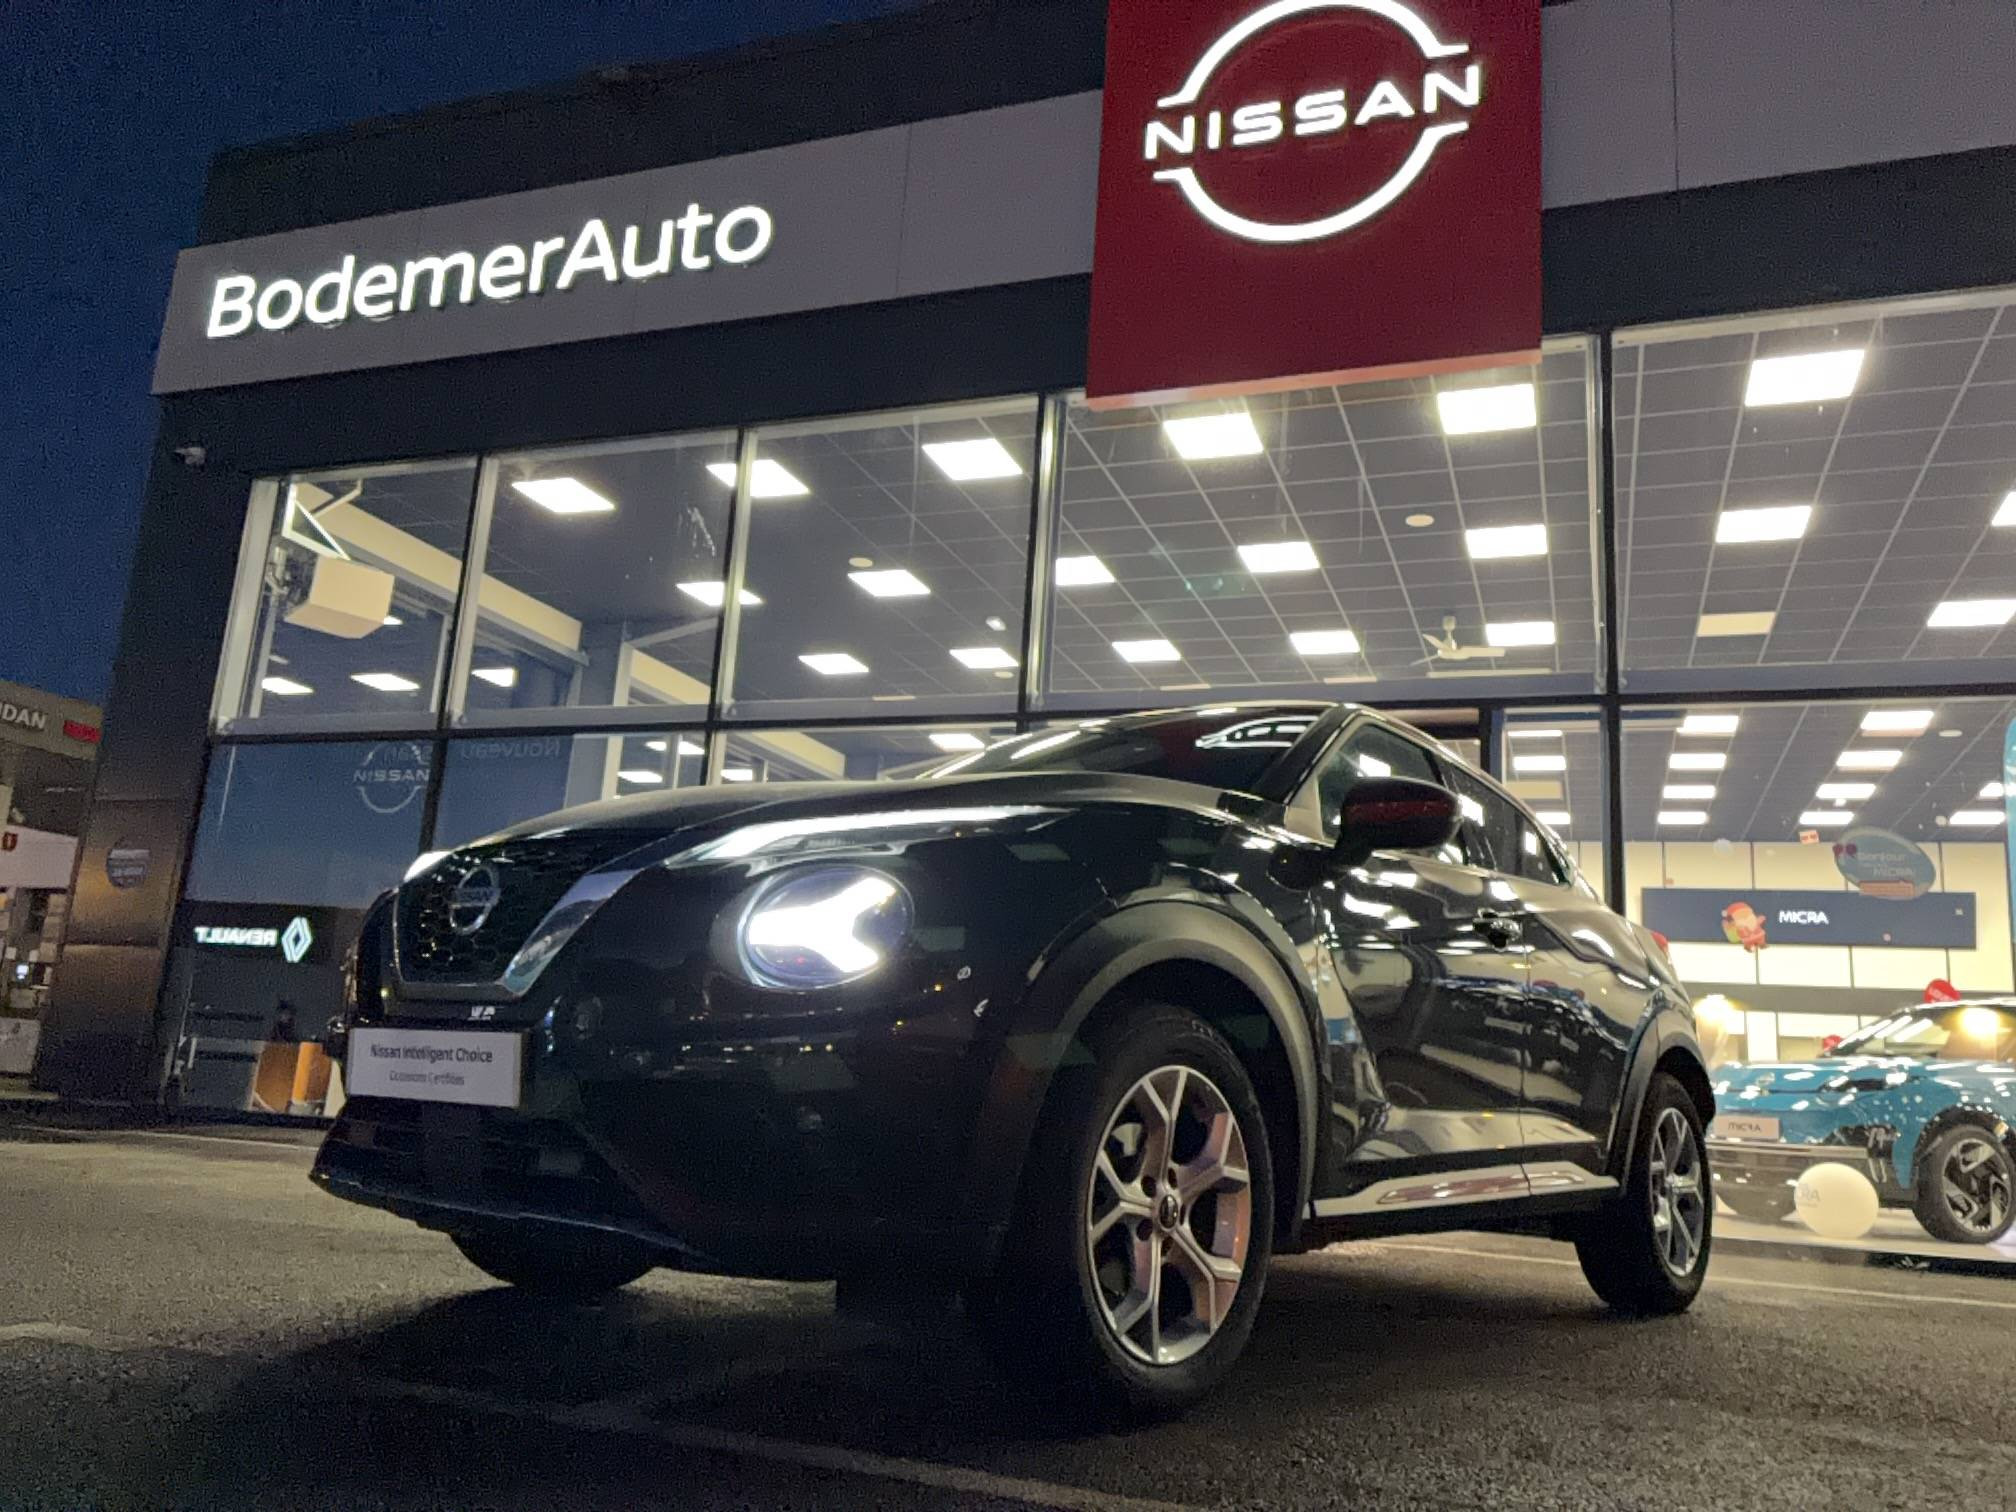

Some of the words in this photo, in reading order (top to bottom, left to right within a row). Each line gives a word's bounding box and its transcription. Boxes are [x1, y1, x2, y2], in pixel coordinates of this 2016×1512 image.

[1144, 63, 1482, 161] NISSAN
[206, 202, 773, 339] BodemerAuto
[353, 768, 431, 783] NISSAN
[1779, 910, 1830, 924] MICRA
[371, 1043, 400, 1059] Nissan
[456, 1046, 493, 1063] Choice
